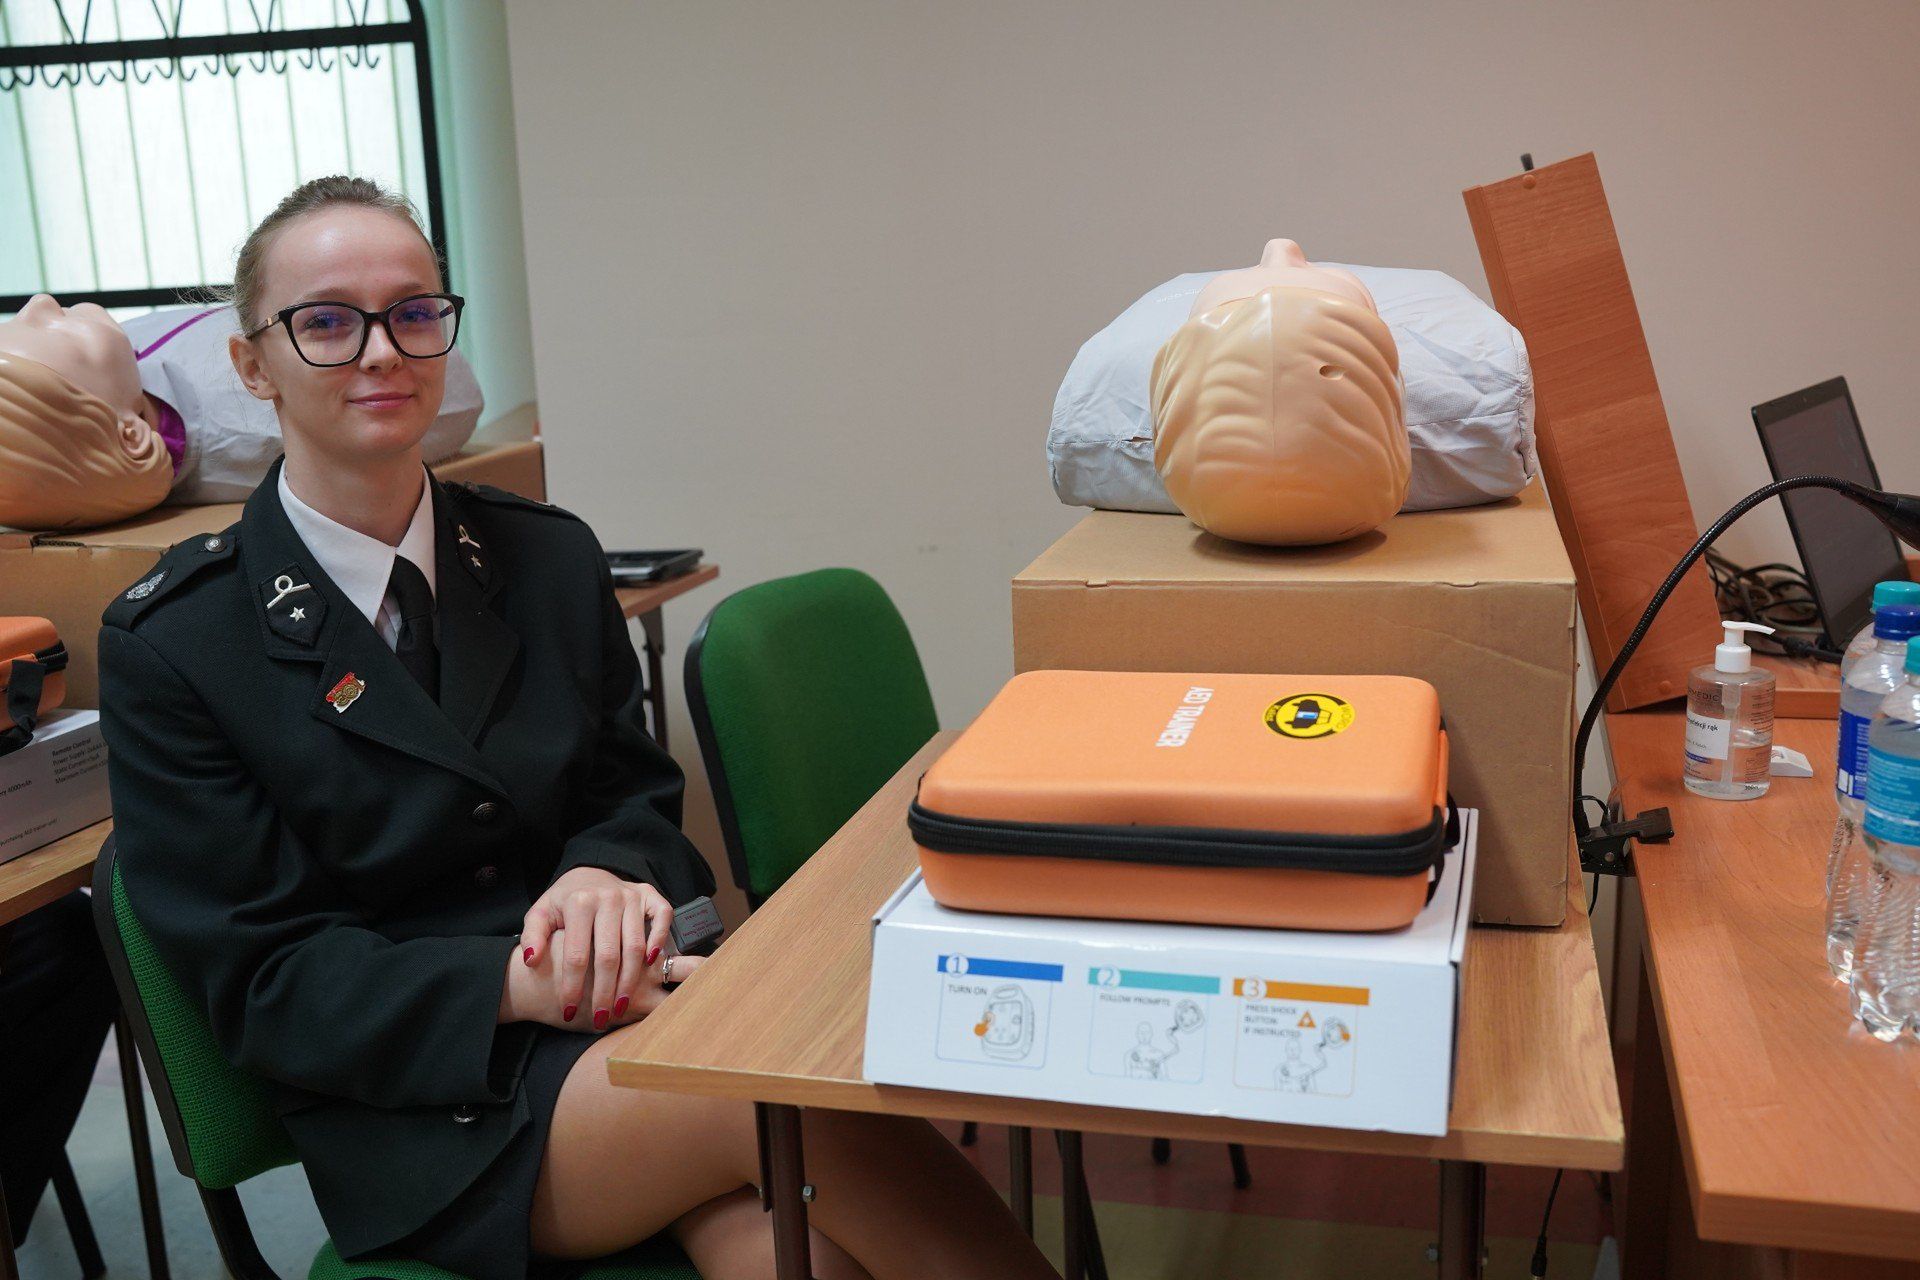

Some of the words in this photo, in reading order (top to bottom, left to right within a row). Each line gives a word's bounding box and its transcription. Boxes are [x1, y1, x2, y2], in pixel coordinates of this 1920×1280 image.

[1183, 686, 1215, 703] AED
[1155, 705, 1206, 747] TRAINER
[52, 745, 72, 757] Remote
[72, 737, 91, 749] Control
[52, 757, 69, 767] Power
[7, 779, 32, 793] 4000mAh
[952, 956, 960, 973] 1
[1103, 968, 1114, 986] 2
[948, 984, 972, 994] TURN
[973, 986, 988, 995] ON
[1247, 979, 1259, 997] 3
[1099, 993, 1131, 1003] FOLLOW
[1132, 996, 1171, 1007] PROMPTS
[1271, 1006, 1296, 1015] SHOCK
[1244, 1016, 1278, 1024] BUTTON
[1252, 1028, 1301, 1039] INSTRUCTED
